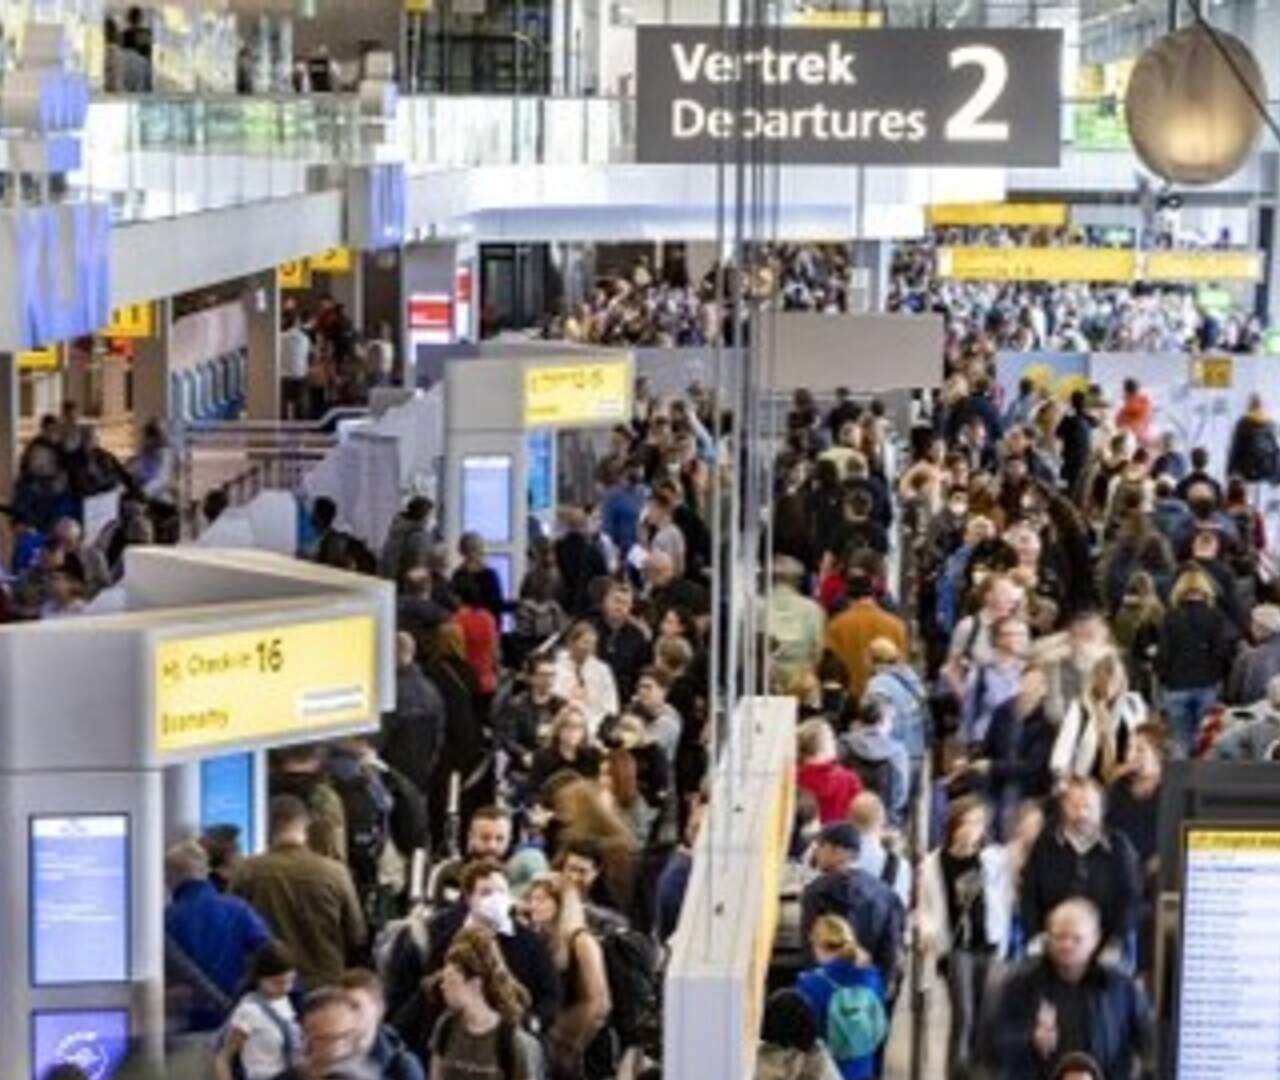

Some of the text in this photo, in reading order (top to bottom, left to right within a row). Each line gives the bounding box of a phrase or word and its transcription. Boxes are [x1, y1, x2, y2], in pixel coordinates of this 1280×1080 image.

[671, 42, 856, 85] Vertrek
[944, 45, 1010, 141] 2
[255, 637, 285, 674] 16
